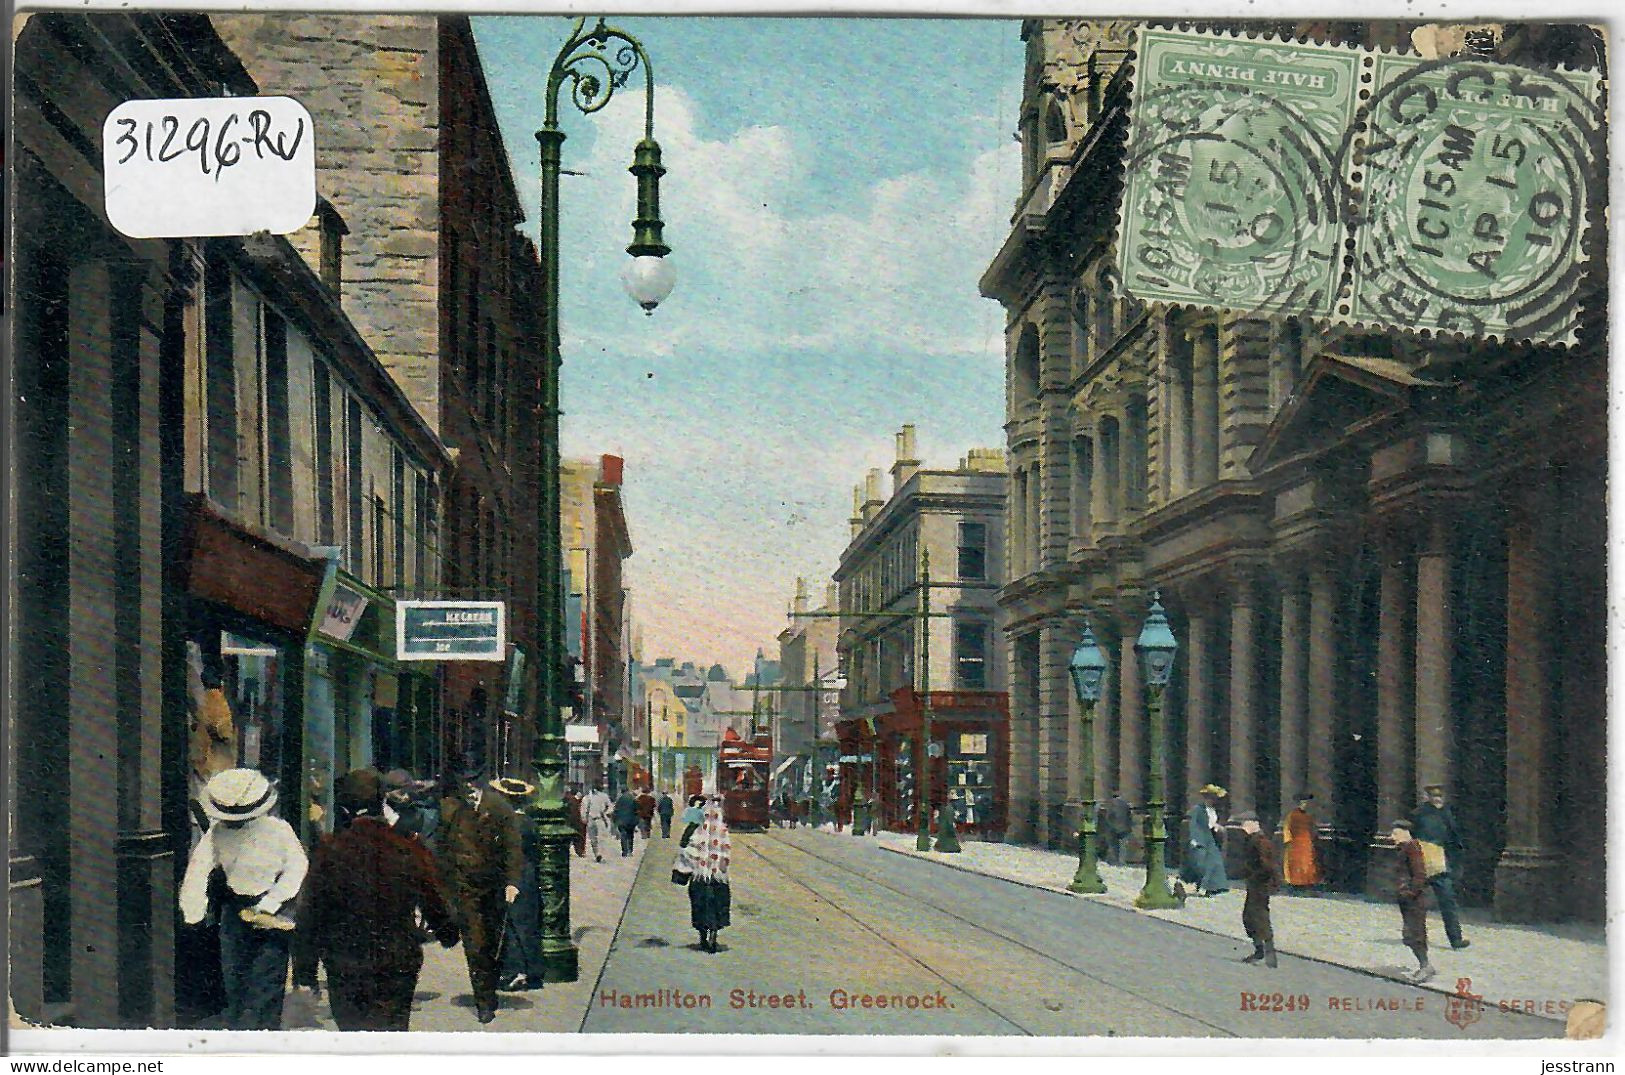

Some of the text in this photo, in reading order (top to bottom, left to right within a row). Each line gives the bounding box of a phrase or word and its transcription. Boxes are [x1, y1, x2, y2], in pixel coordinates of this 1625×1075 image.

[1171, 60, 1328, 90] HALF PENNY
[1467, 133, 1527, 280] AP 15
[1524, 191, 1565, 247] 10
[600, 989, 712, 1009] Hamilton
[829, 988, 956, 1010] Greenock.
[1240, 991, 1569, 1014] R2249 RELIABLE SERIES
